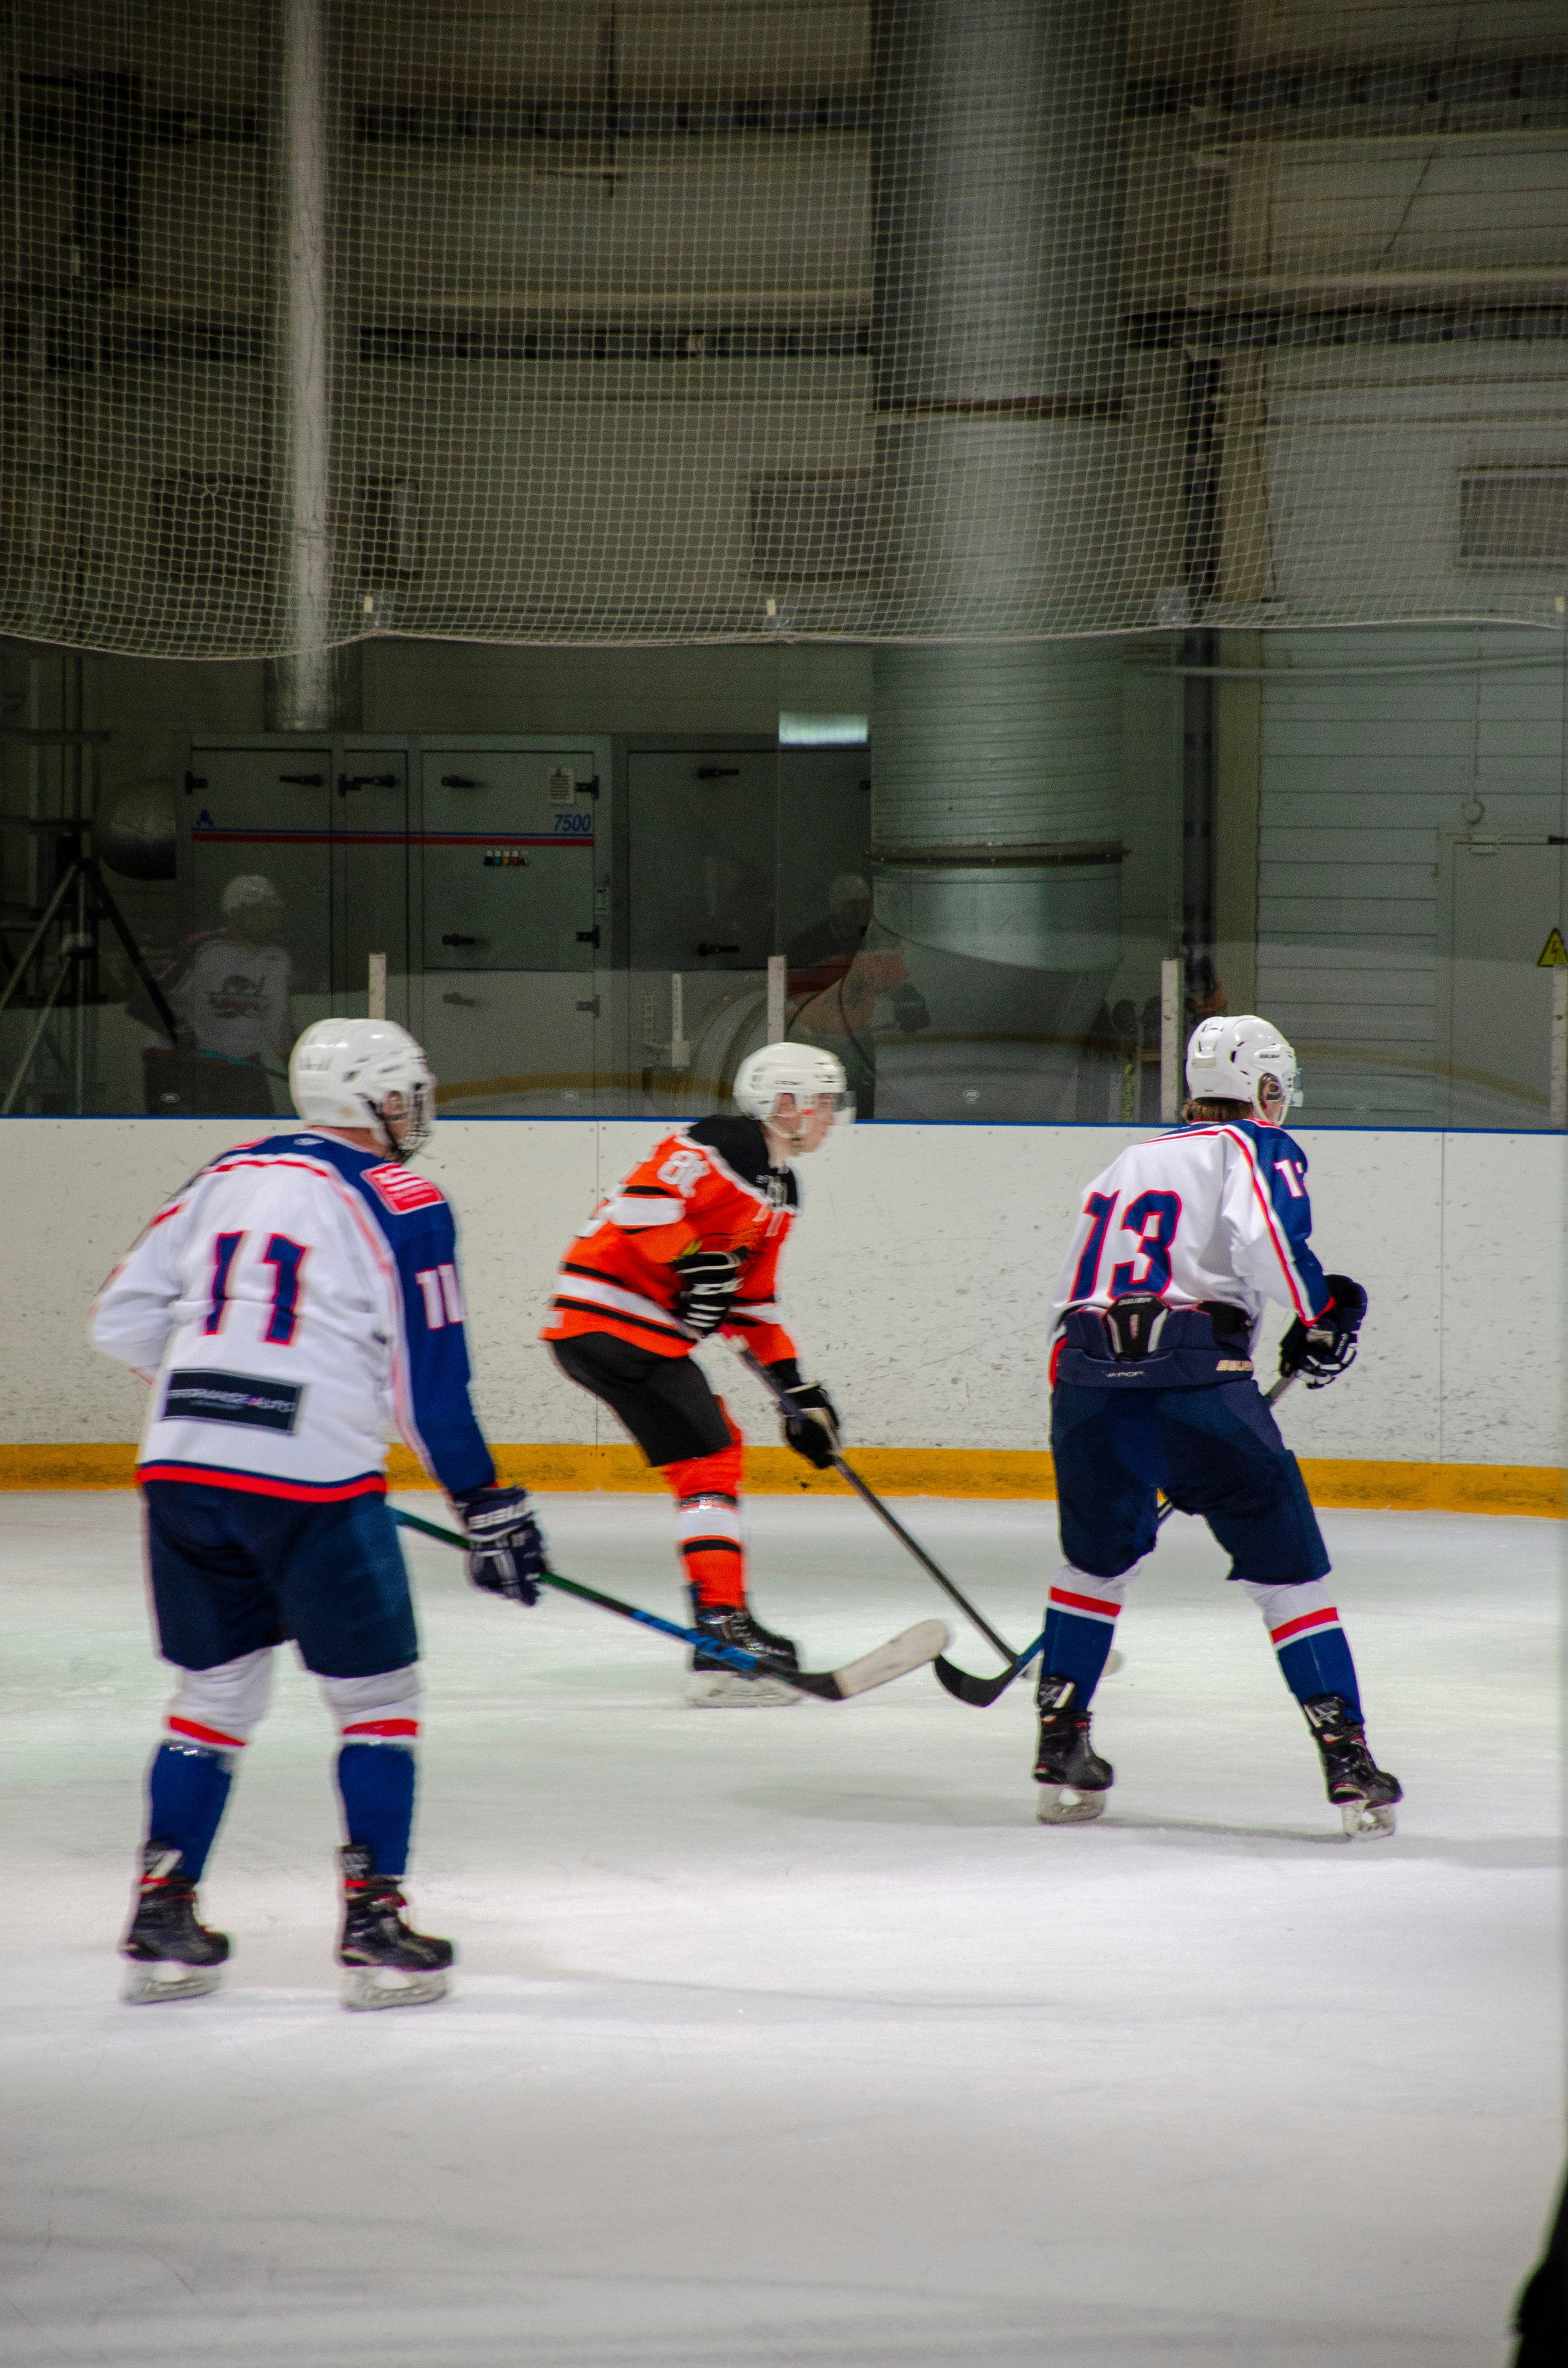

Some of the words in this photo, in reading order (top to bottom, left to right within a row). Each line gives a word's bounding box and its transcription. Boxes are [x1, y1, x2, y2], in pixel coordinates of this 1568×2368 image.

[554, 814, 592, 832] 7500
[1273, 1158, 1304, 1198] 1
[1069, 1189, 1182, 1303] 13
[199, 1229, 312, 1346] 11
[415, 1262, 468, 1330] 11
